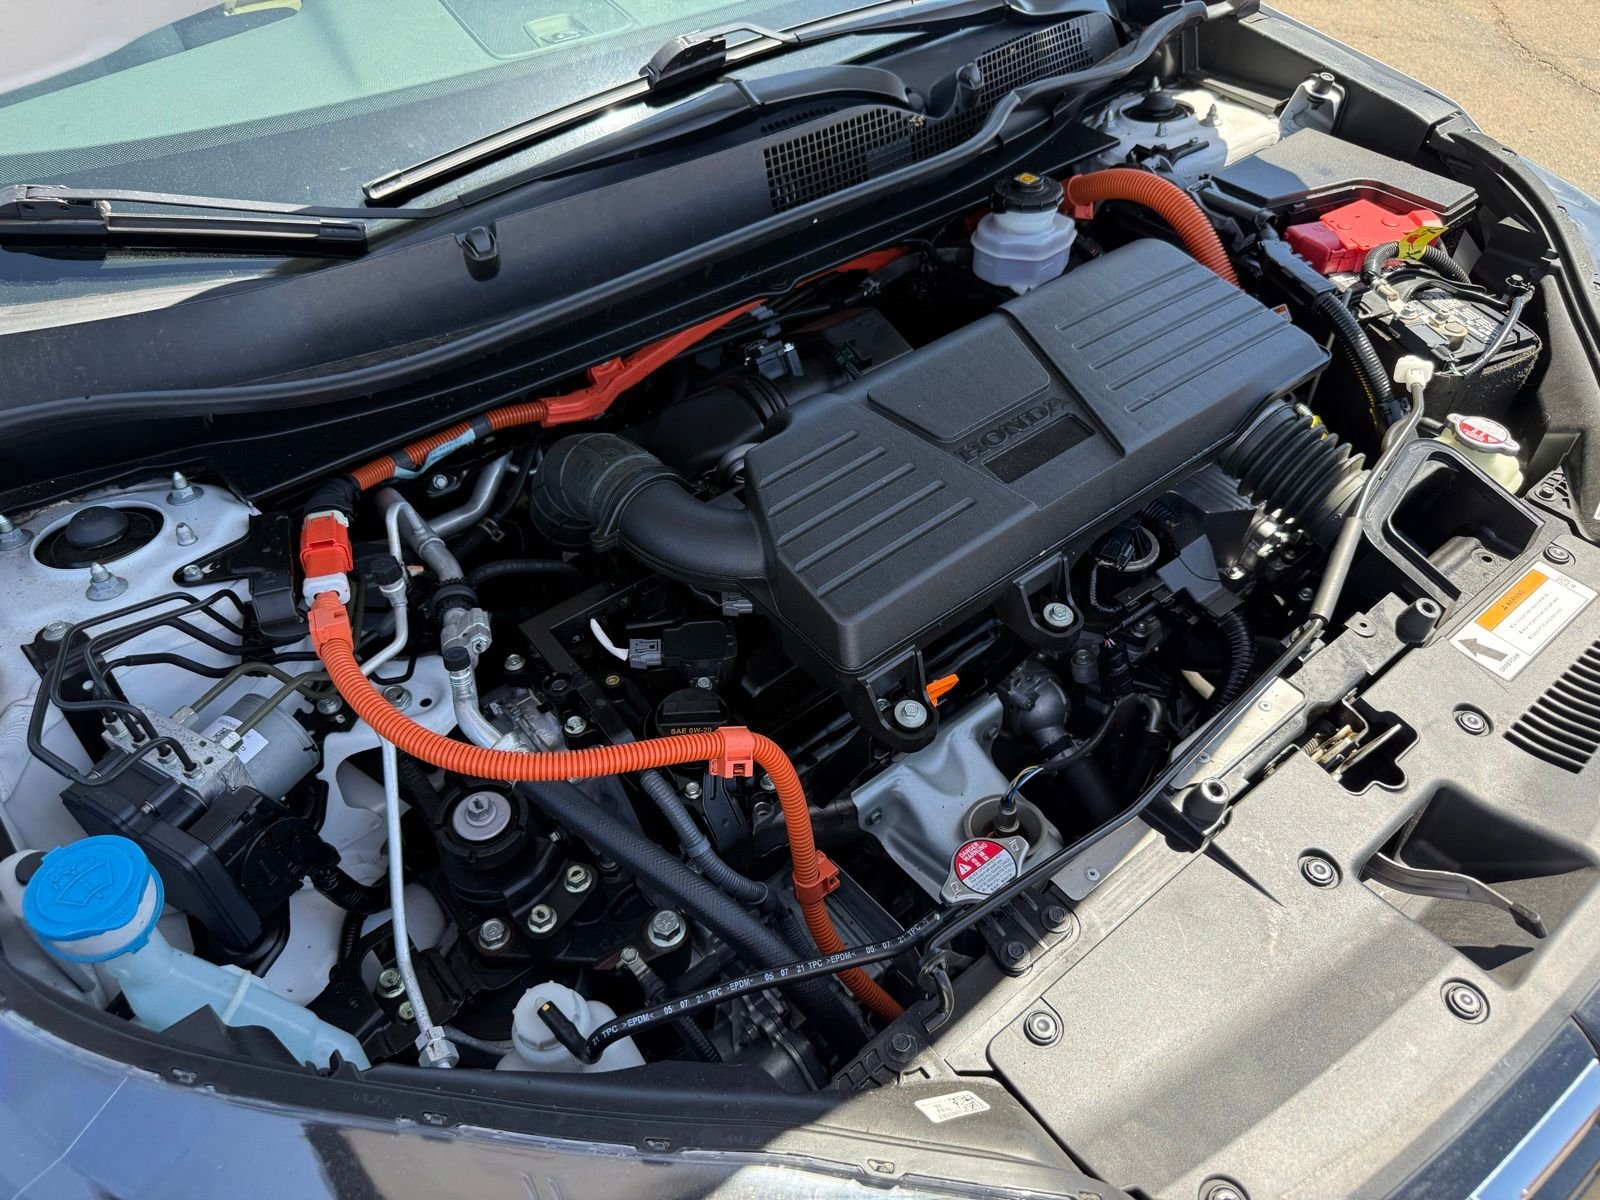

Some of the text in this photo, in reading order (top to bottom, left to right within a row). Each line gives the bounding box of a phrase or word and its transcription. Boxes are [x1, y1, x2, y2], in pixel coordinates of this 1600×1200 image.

[954, 398, 1073, 463] HONDA
[688, 726, 712, 734] 0W-20
[958, 841, 979, 857] DANGER
[602, 1025, 619, 1038] TPC
[663, 1005, 673, 1015] 05
[680, 999, 689, 1009] 07
[707, 987, 723, 999] TPC
[764, 972, 775, 981] 05
[780, 968, 789, 977] 07
[796, 963, 805, 973] 21
[808, 959, 823, 970] TPC
[865, 945, 875, 954] 05
[882, 940, 891, 949] 07
[907, 925, 921, 937] TPC
